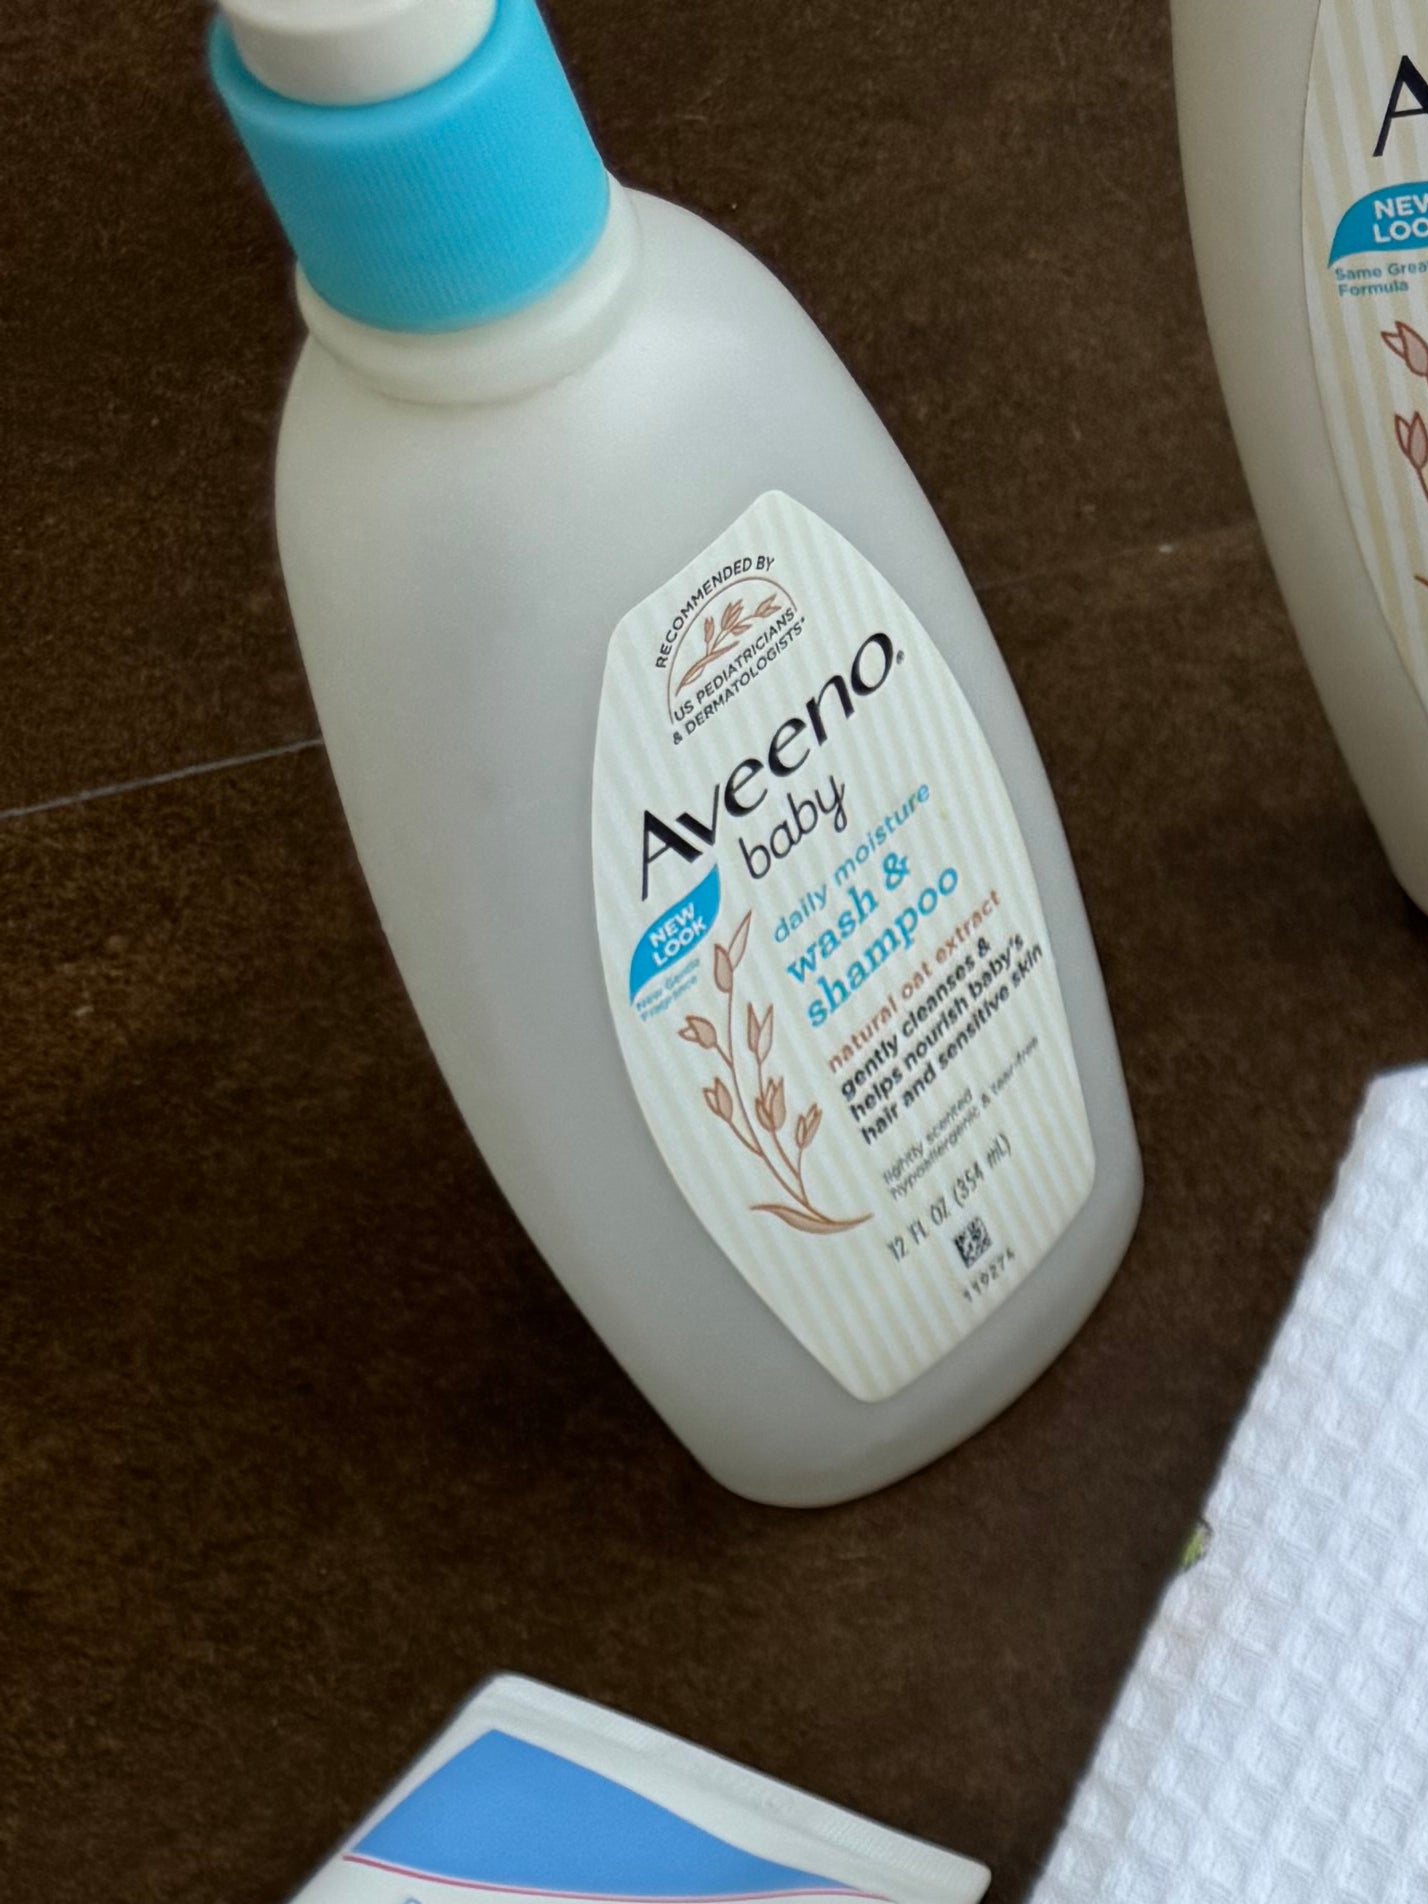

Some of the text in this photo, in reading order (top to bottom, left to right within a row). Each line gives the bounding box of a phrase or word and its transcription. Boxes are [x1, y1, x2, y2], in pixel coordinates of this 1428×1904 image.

[1335, 266, 1382, 281] Same
[1338, 279, 1409, 297] Formula
[655, 555, 775, 668] RECOMMENDED BY
[673, 608, 795, 722] US PEDIATRICIANS
[672, 731, 683, 745] &
[739, 776, 849, 879] baby
[773, 784, 930, 944] daily moisture
[649, 902, 695, 948] NEW
[652, 915, 707, 966] LOOK
[786, 852, 910, 986] wash &
[807, 867, 959, 1028] shampoo
[827, 889, 1001, 1074] natural oat extract
[841, 936, 991, 1103] gently cleanses &
[849, 933, 1024, 1122] helps nourish baby's
[860, 943, 1043, 1145] hair and sensitive skin
[926, 1087, 973, 1144] scented
[887, 1235, 909, 1263] 12
[952, 1161, 984, 1209] (354
